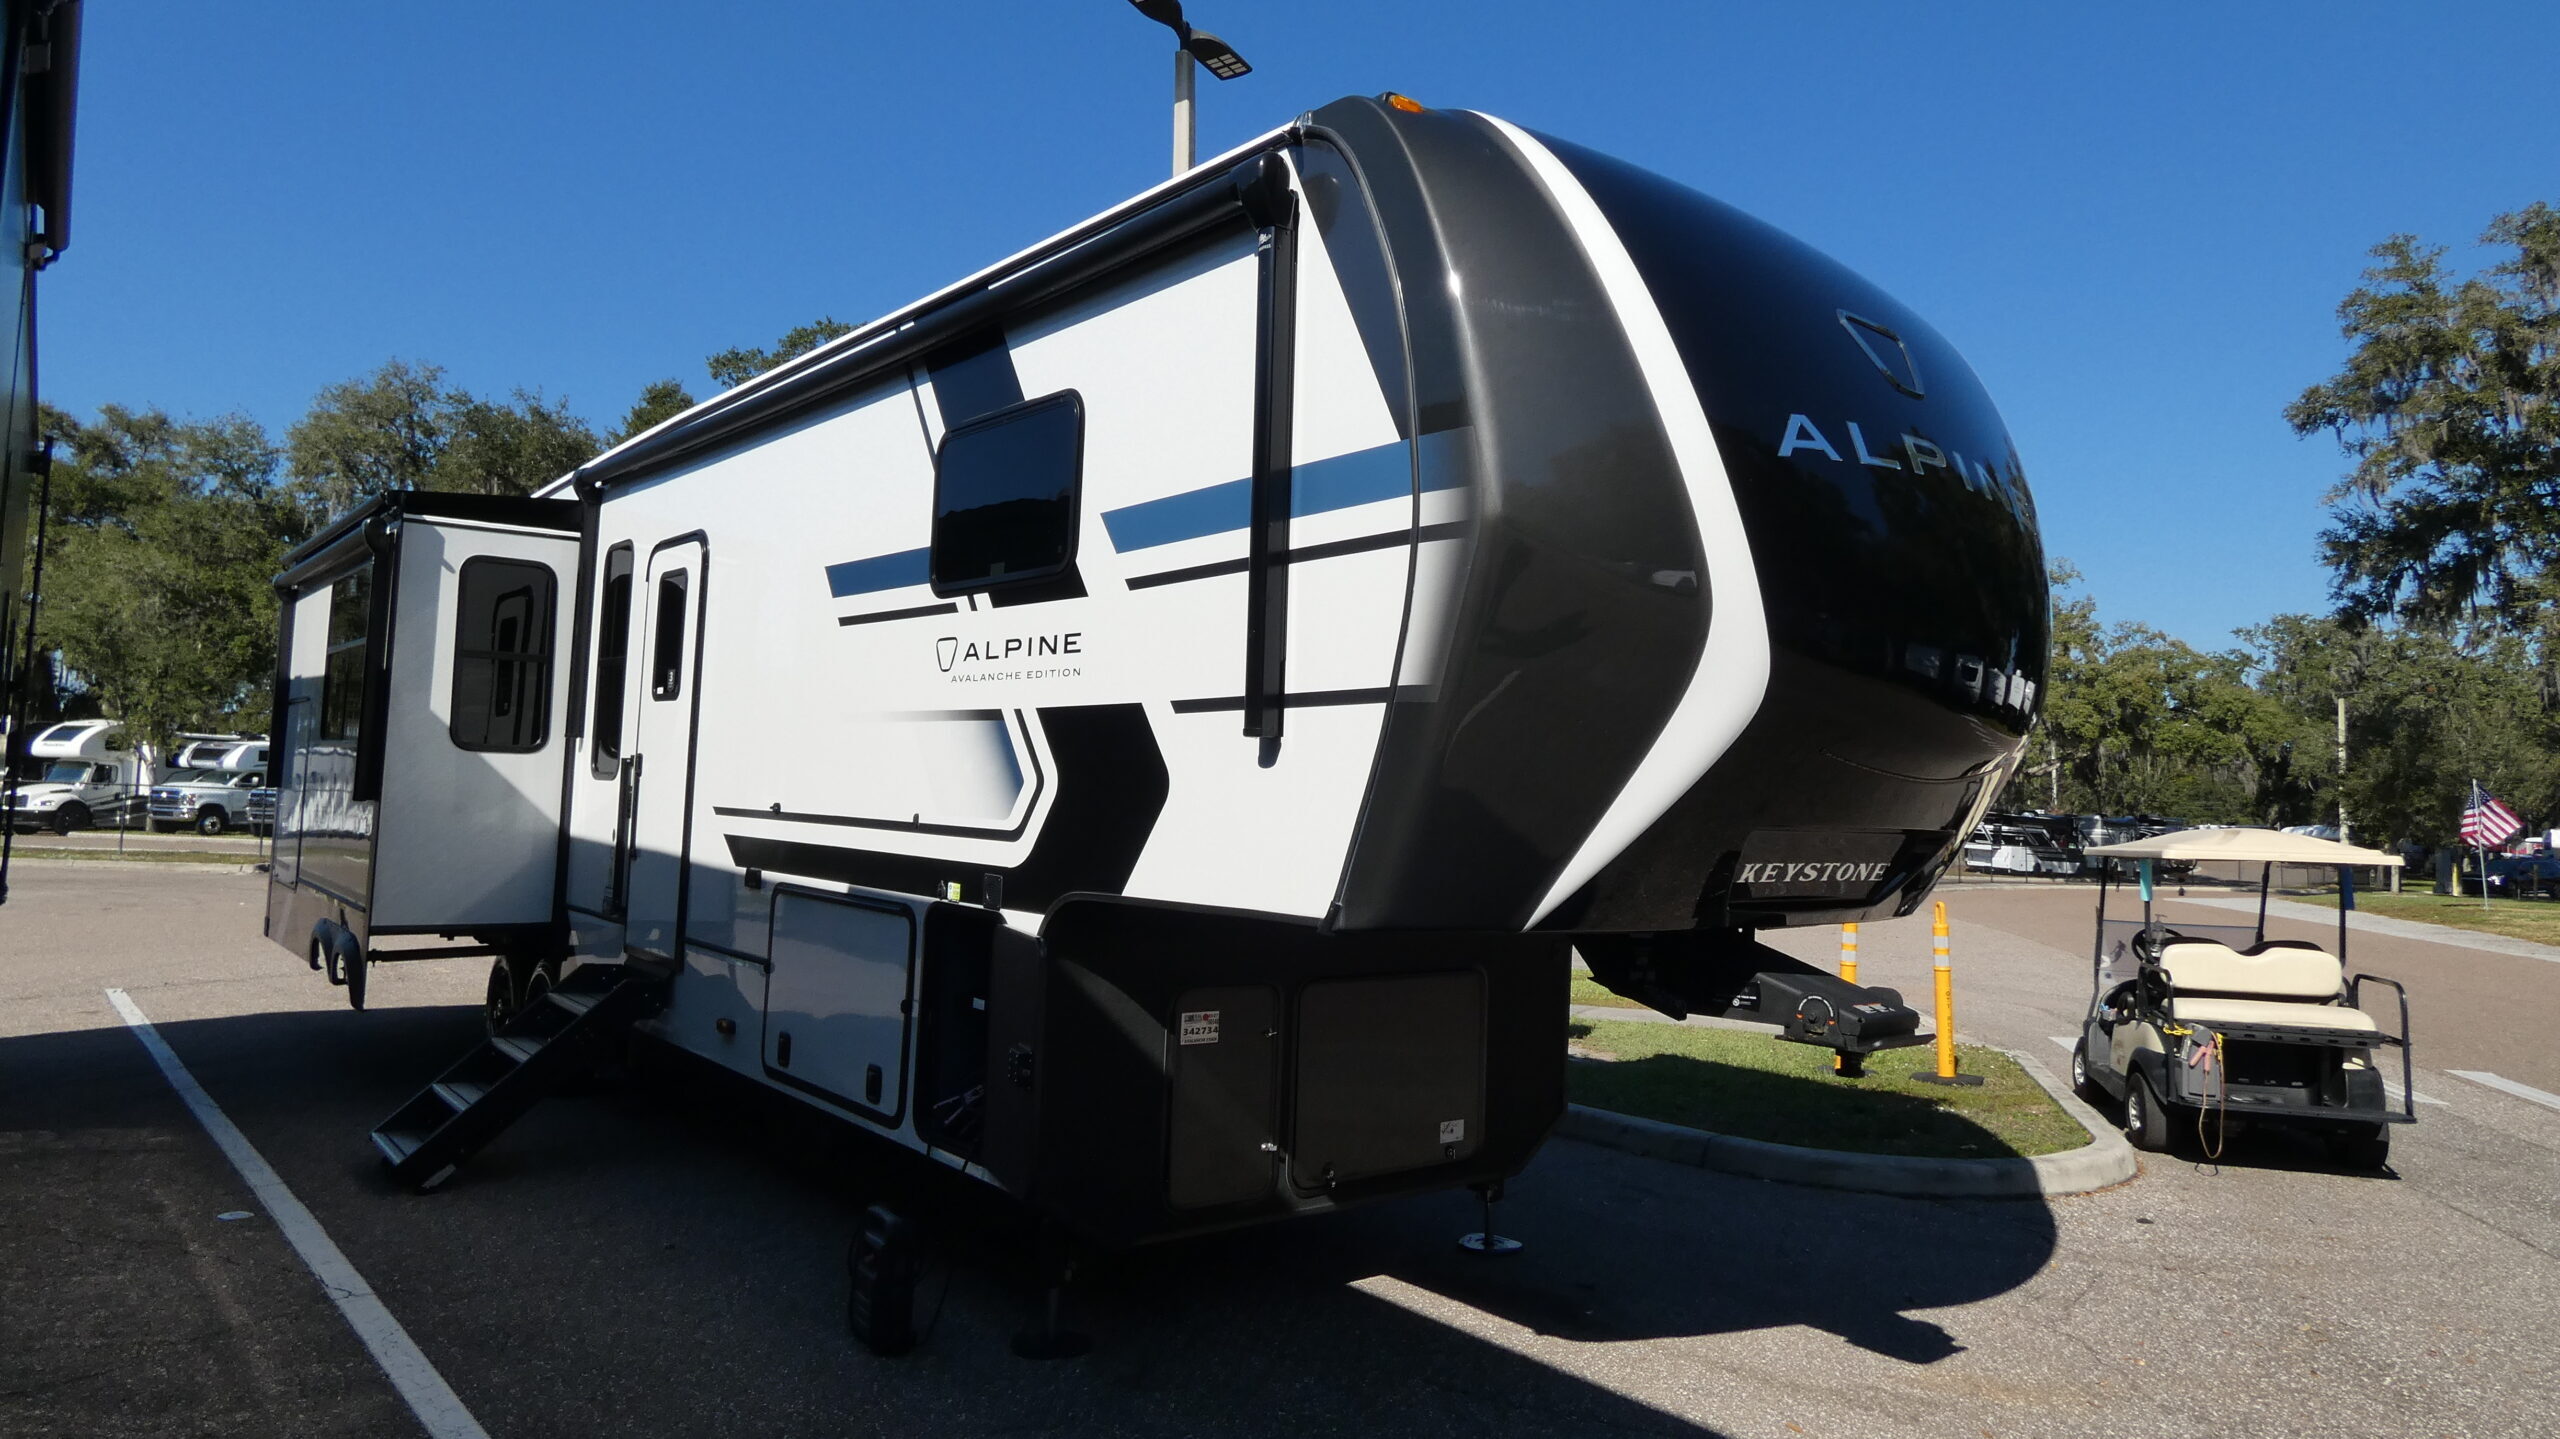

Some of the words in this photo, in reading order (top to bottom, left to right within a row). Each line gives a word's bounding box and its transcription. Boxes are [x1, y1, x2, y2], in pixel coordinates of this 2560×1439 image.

[963, 632, 1082, 662] ALPINE
[951, 671, 1022, 683] AVALANCHE
[1026, 668, 1081, 679] EDITION
[1736, 862, 1891, 883] KEYSTONE
